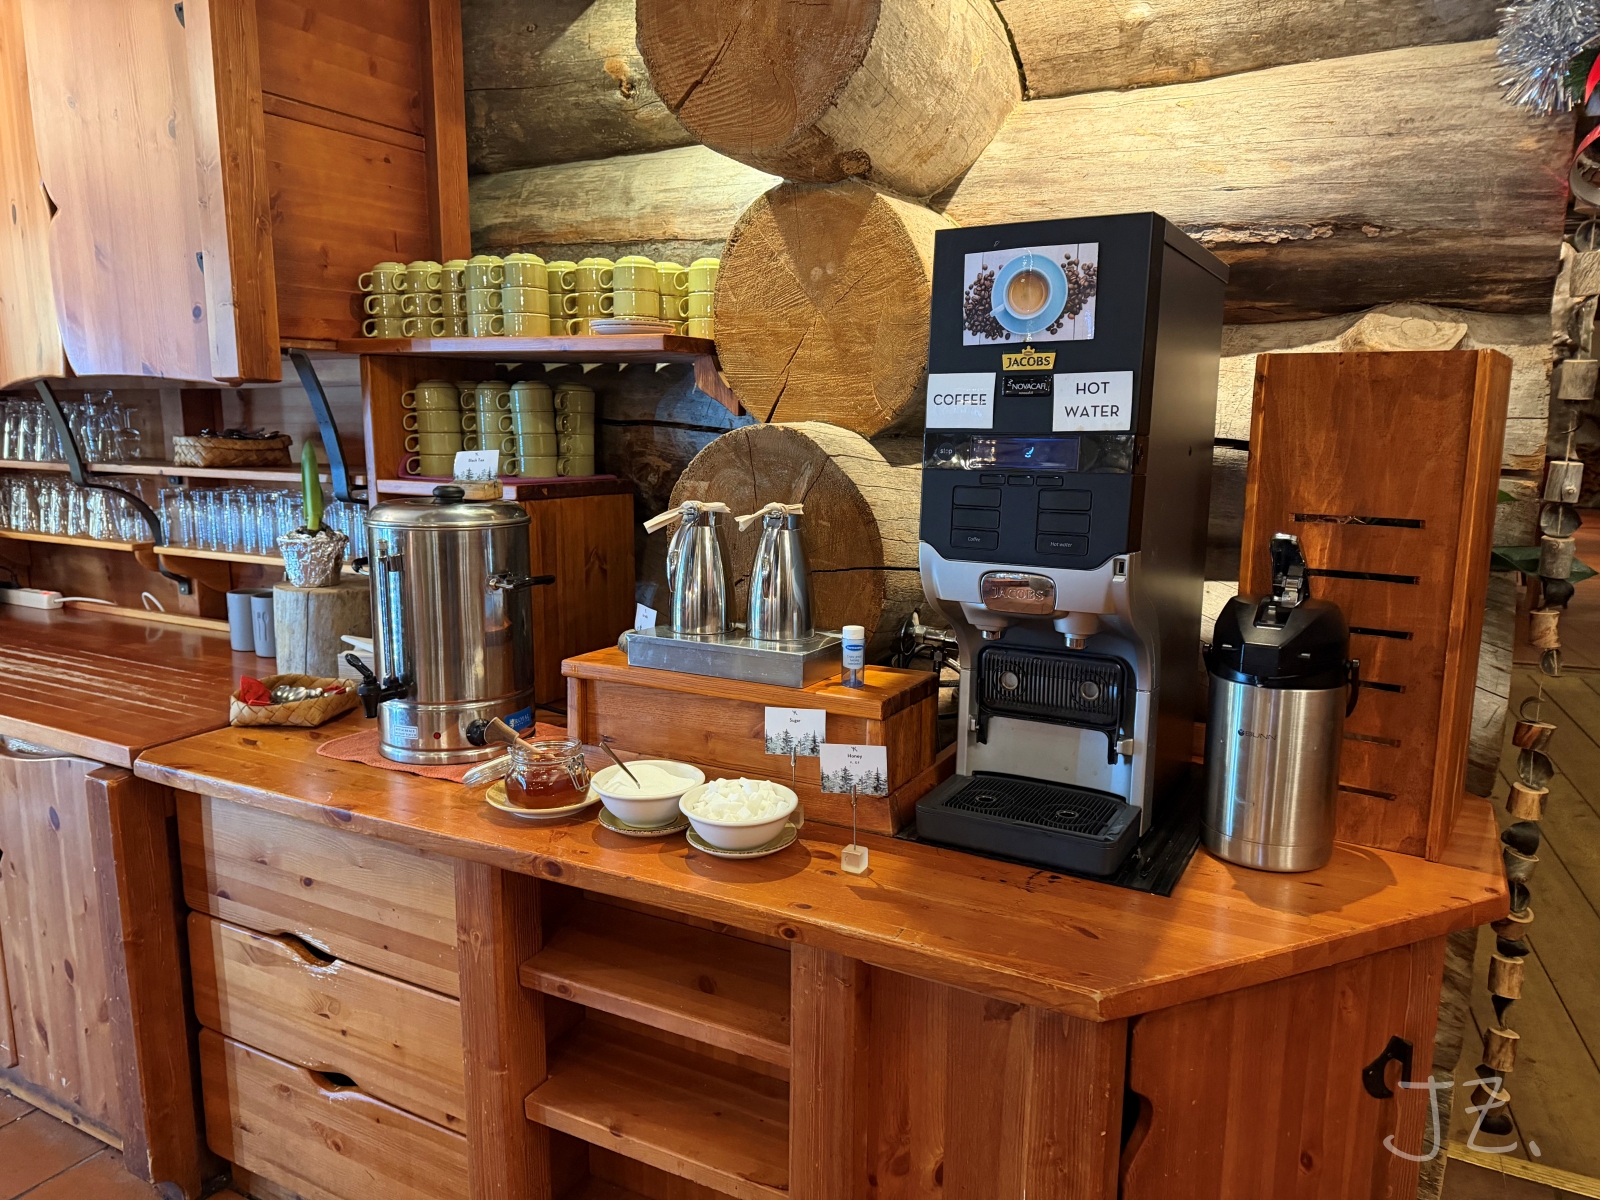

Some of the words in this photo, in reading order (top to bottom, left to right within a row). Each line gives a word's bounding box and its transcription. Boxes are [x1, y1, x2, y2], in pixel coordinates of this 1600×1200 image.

[1006, 356, 1051, 369] JACOBS
[1076, 381, 1110, 395] HOT
[933, 393, 987, 406] COFFEE
[1064, 404, 1120, 418] WATER
[991, 586, 1044, 601] JACOBS
